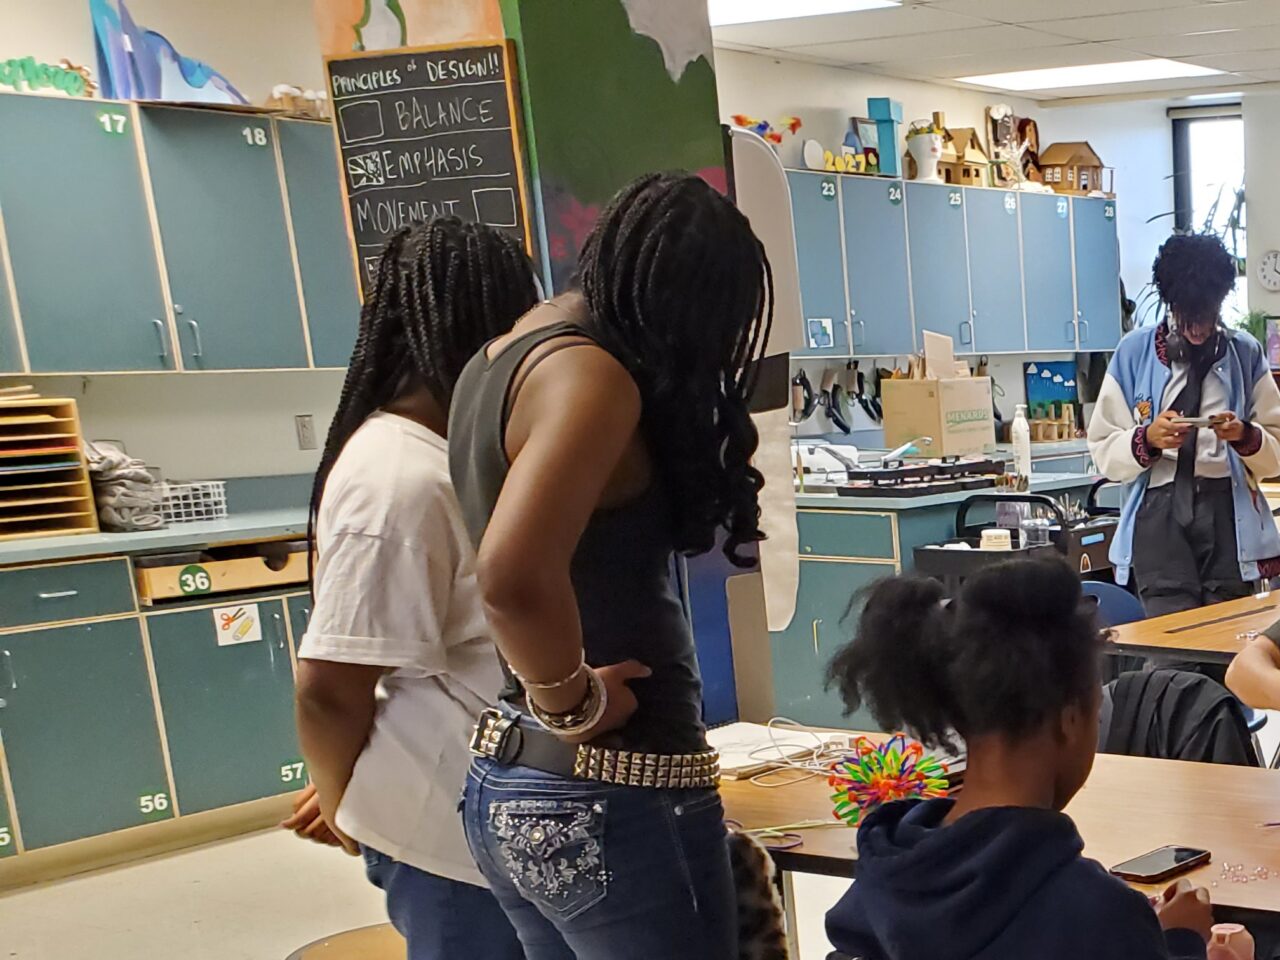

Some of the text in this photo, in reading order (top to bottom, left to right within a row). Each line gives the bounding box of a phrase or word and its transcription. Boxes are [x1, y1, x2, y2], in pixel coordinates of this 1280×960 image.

[332, 68, 402, 96] PRINCIPLES
[426, 52, 500, 83] DESIGN!!
[395, 96, 494, 131] BALANCE
[100, 114, 127, 133] 17
[242, 127, 267, 146] 18
[383, 144, 484, 179] EMPHASIS
[822, 182, 836, 196] 23
[889, 187, 902, 201] 24
[949, 192, 962, 205] 25
[1005, 197, 1017, 209] 26
[1057, 202, 1068, 214] 27
[1104, 205, 1115, 217] 28
[181, 572, 210, 592] 36
[281, 762, 305, 782] 57
[140, 793, 168, 813] 56
[0, 826, 11, 846] 5
